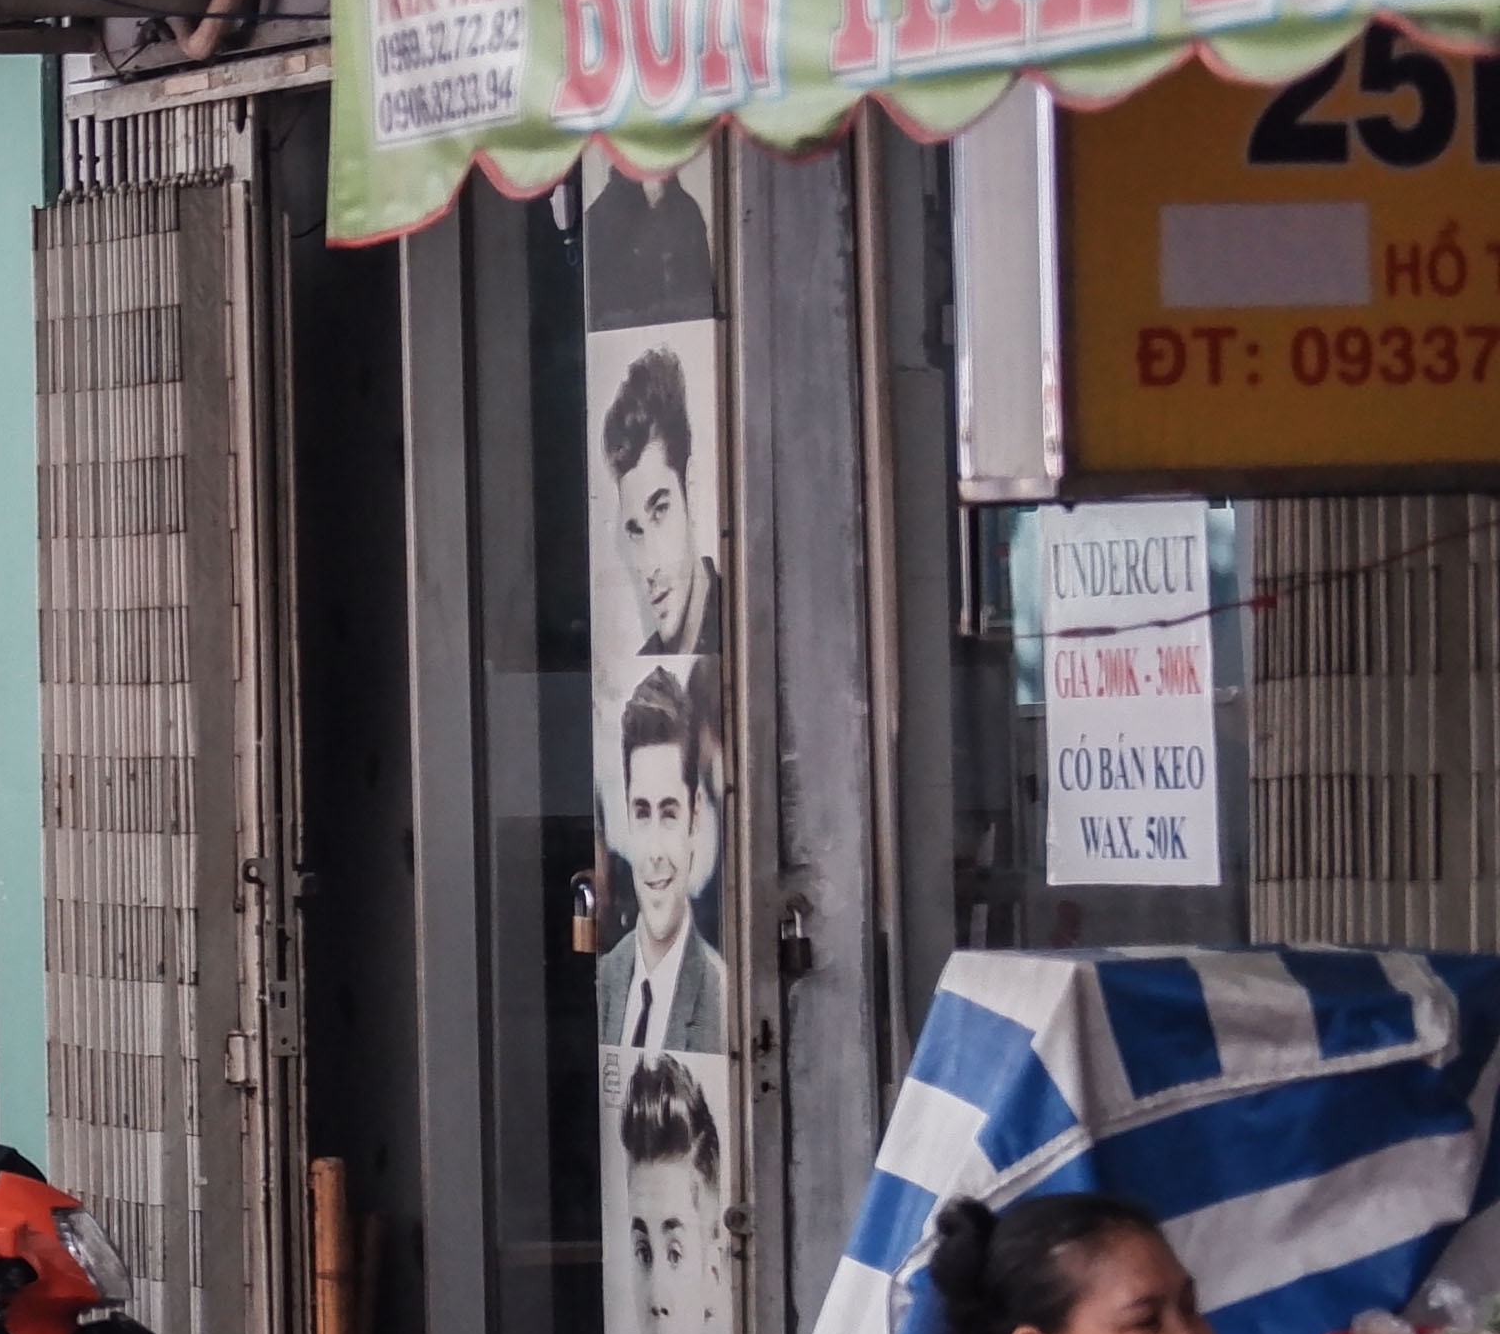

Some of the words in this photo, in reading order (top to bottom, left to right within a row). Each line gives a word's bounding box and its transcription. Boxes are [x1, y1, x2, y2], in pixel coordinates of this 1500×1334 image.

[1137, 327, 1262, 387] ĐT:
[1052, 534, 1197, 601] UNDERCUT
[1058, 733, 1092, 792] CÓ
[1100, 732, 1148, 792] BÁN
[1153, 745, 1206, 791] KEO
[1145, 816, 1189, 860] 50K
